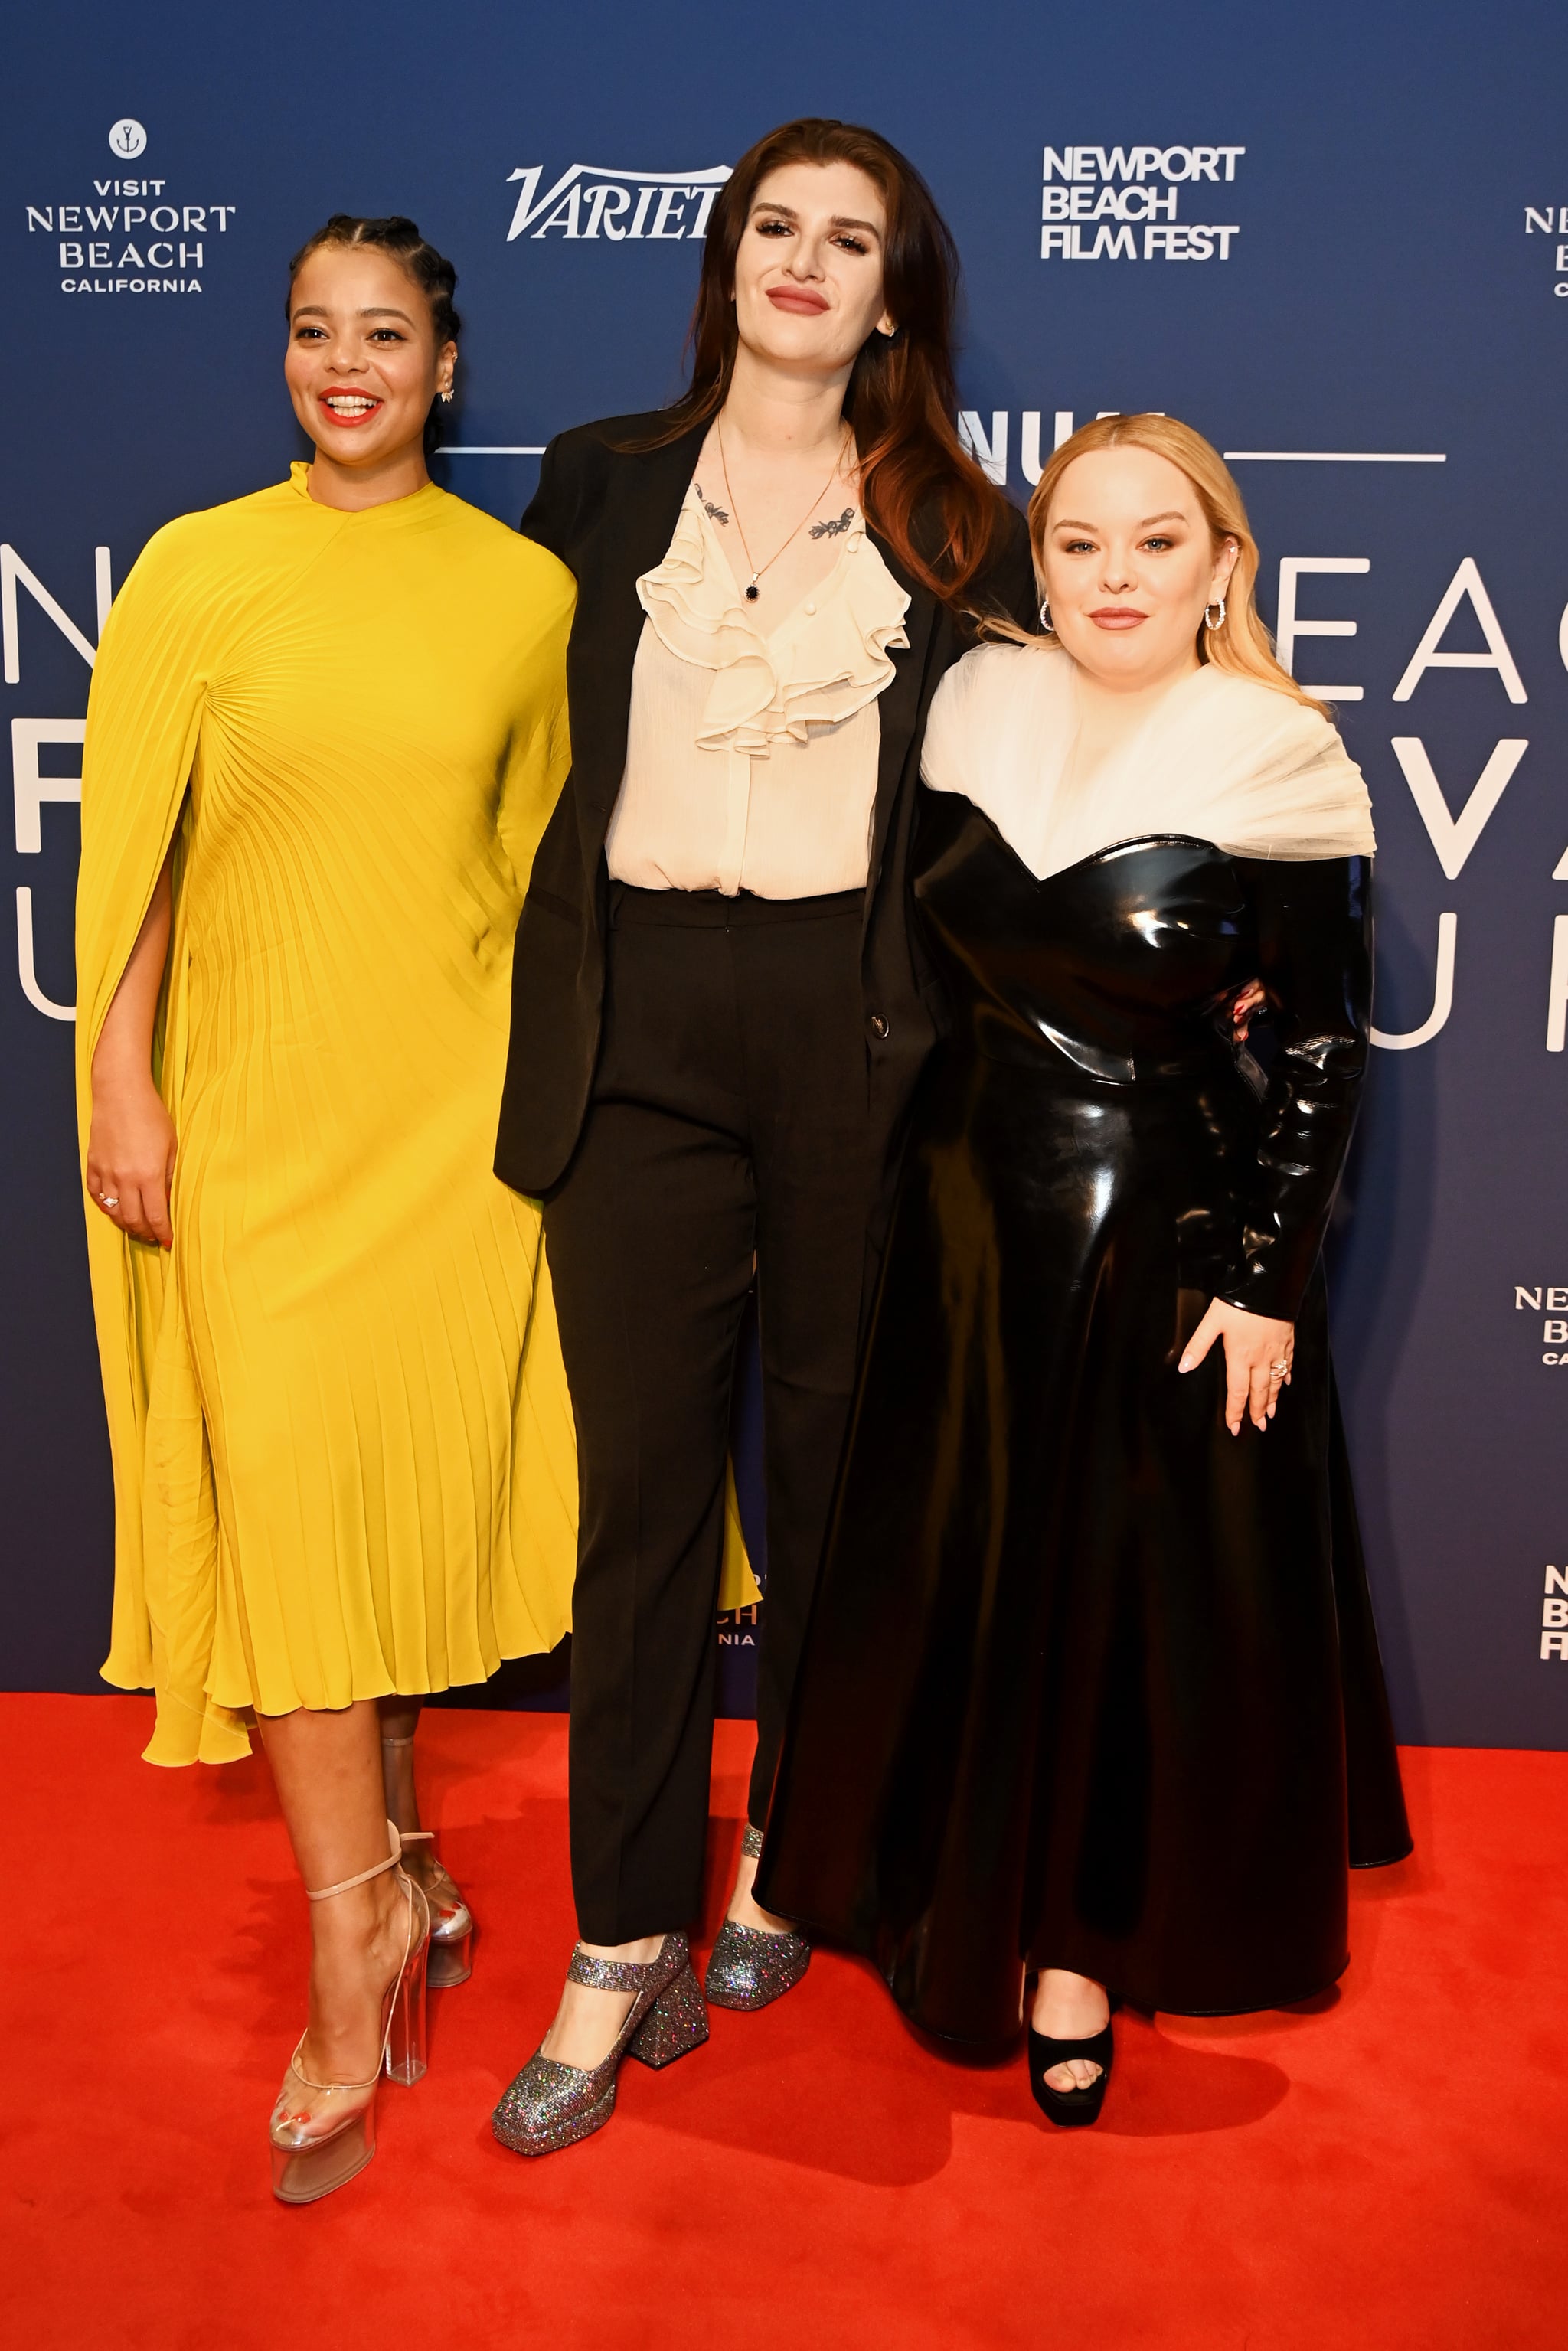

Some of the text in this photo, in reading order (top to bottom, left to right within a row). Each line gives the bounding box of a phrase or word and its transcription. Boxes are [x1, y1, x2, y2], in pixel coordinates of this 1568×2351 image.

[1043, 145, 1246, 182] NEWPORT
[93, 179, 166, 197] VISIT
[505, 163, 734, 242] VARIET
[1041, 185, 1178, 221] BEACH
[25, 206, 236, 233] NEWPORT
[60, 242, 204, 269] BEACH
[1040, 225, 1240, 260] FILM FEST
[60, 279, 202, 293] CALIFORNIA
